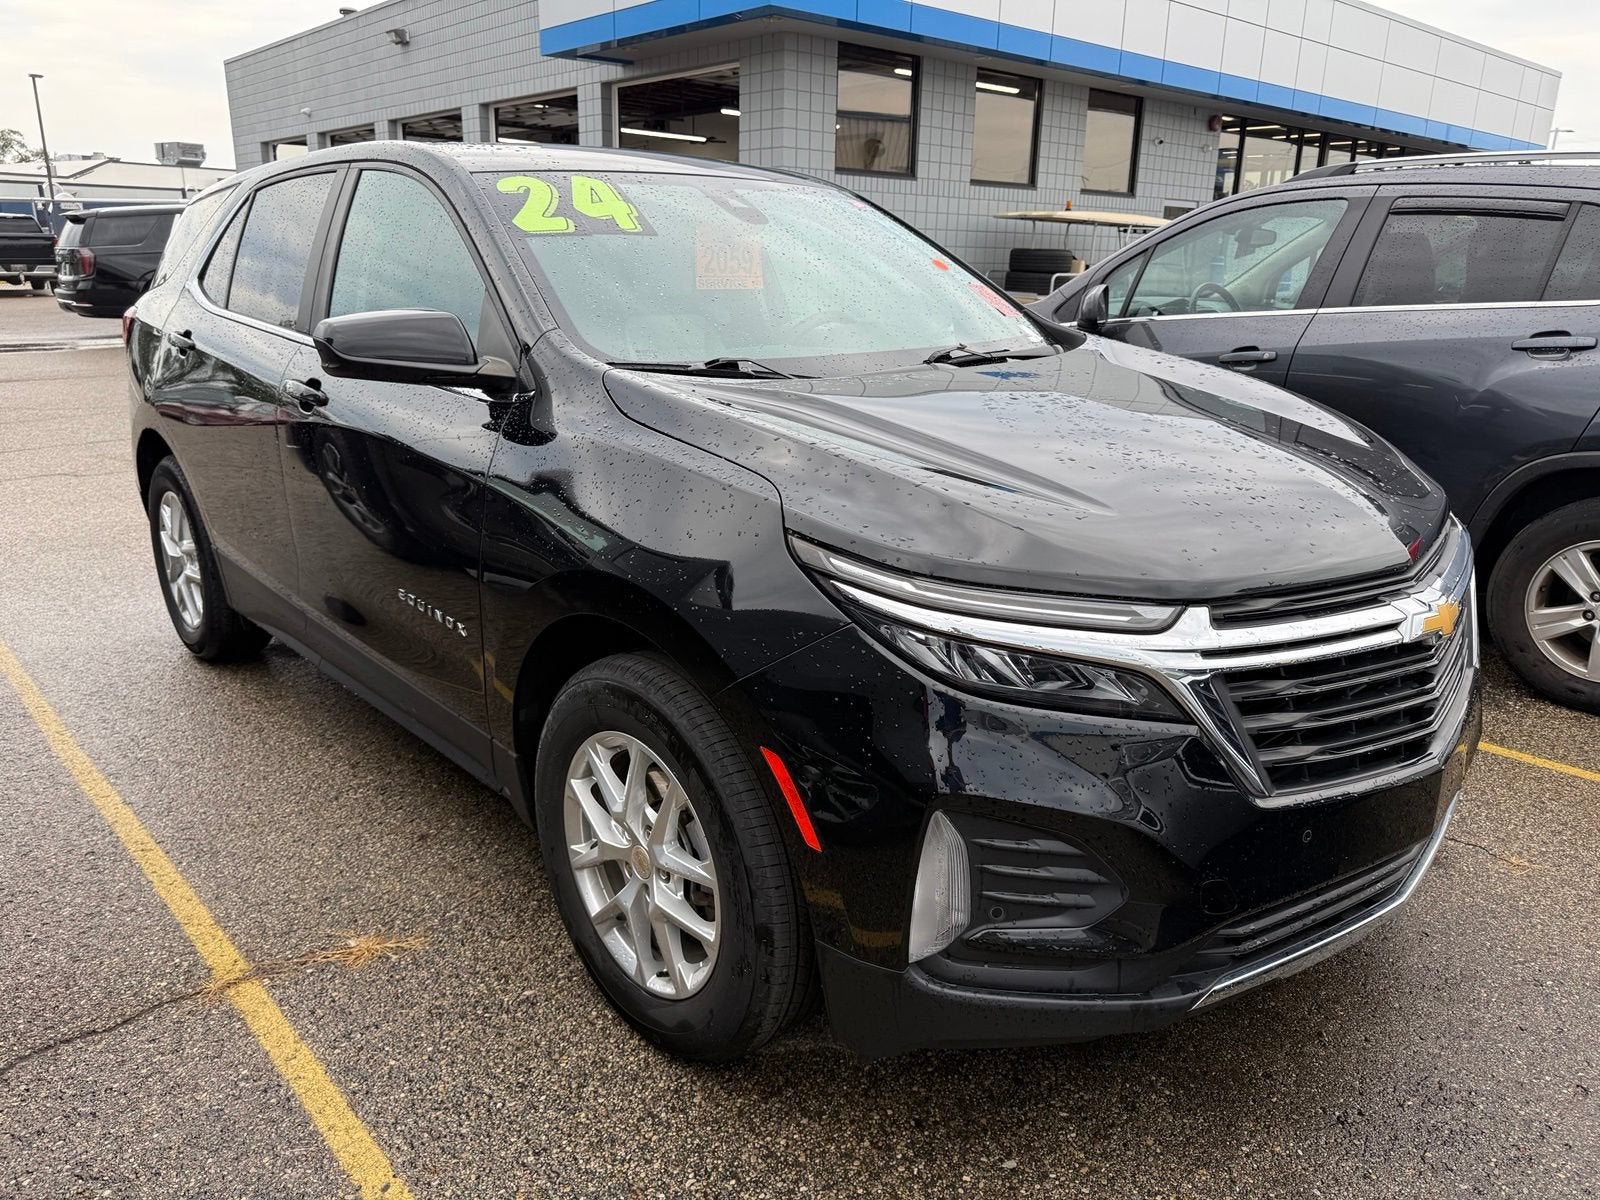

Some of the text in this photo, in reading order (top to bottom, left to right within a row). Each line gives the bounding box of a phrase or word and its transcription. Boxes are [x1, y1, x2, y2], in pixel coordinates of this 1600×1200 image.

[496, 175, 643, 233] 24
[702, 244, 754, 274] 2059
[398, 588, 468, 637] EQUINOX
